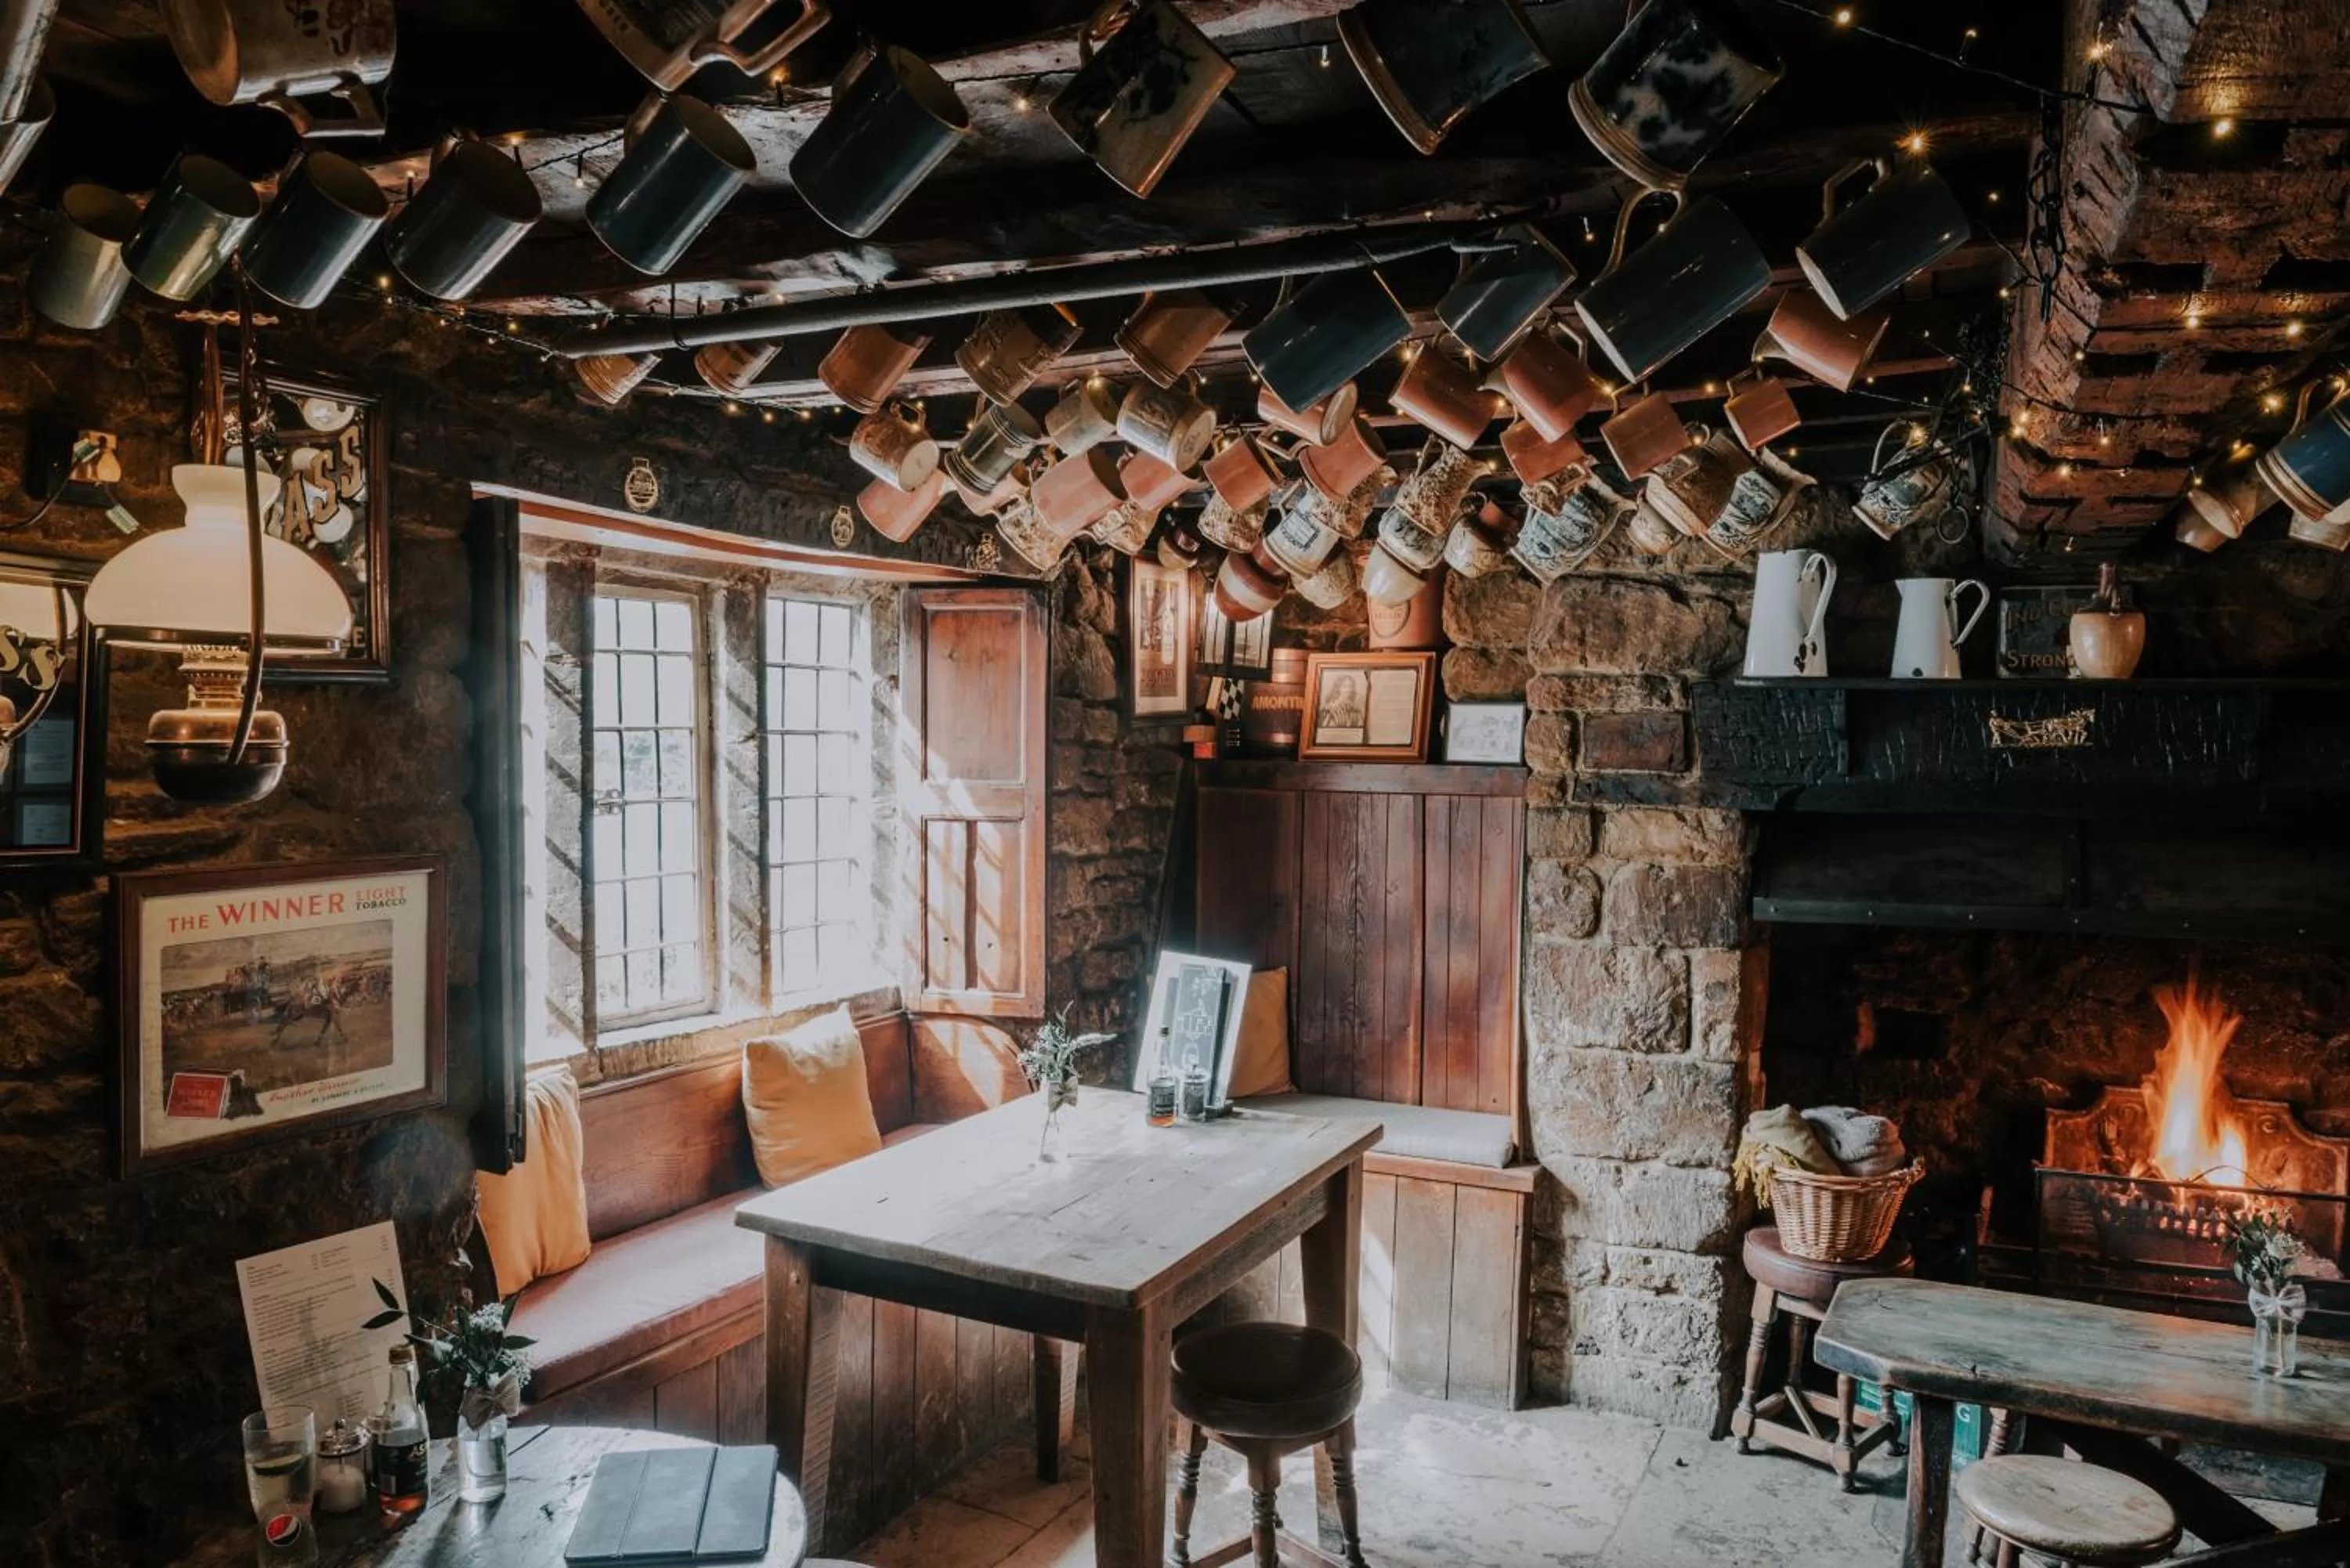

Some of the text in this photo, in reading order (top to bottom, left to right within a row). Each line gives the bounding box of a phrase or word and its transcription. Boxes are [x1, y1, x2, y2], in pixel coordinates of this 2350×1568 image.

[356, 886, 407, 901] LIGHT
[354, 898, 407, 911] TOBACCO
[168, 893, 345, 934] THE WINNER
